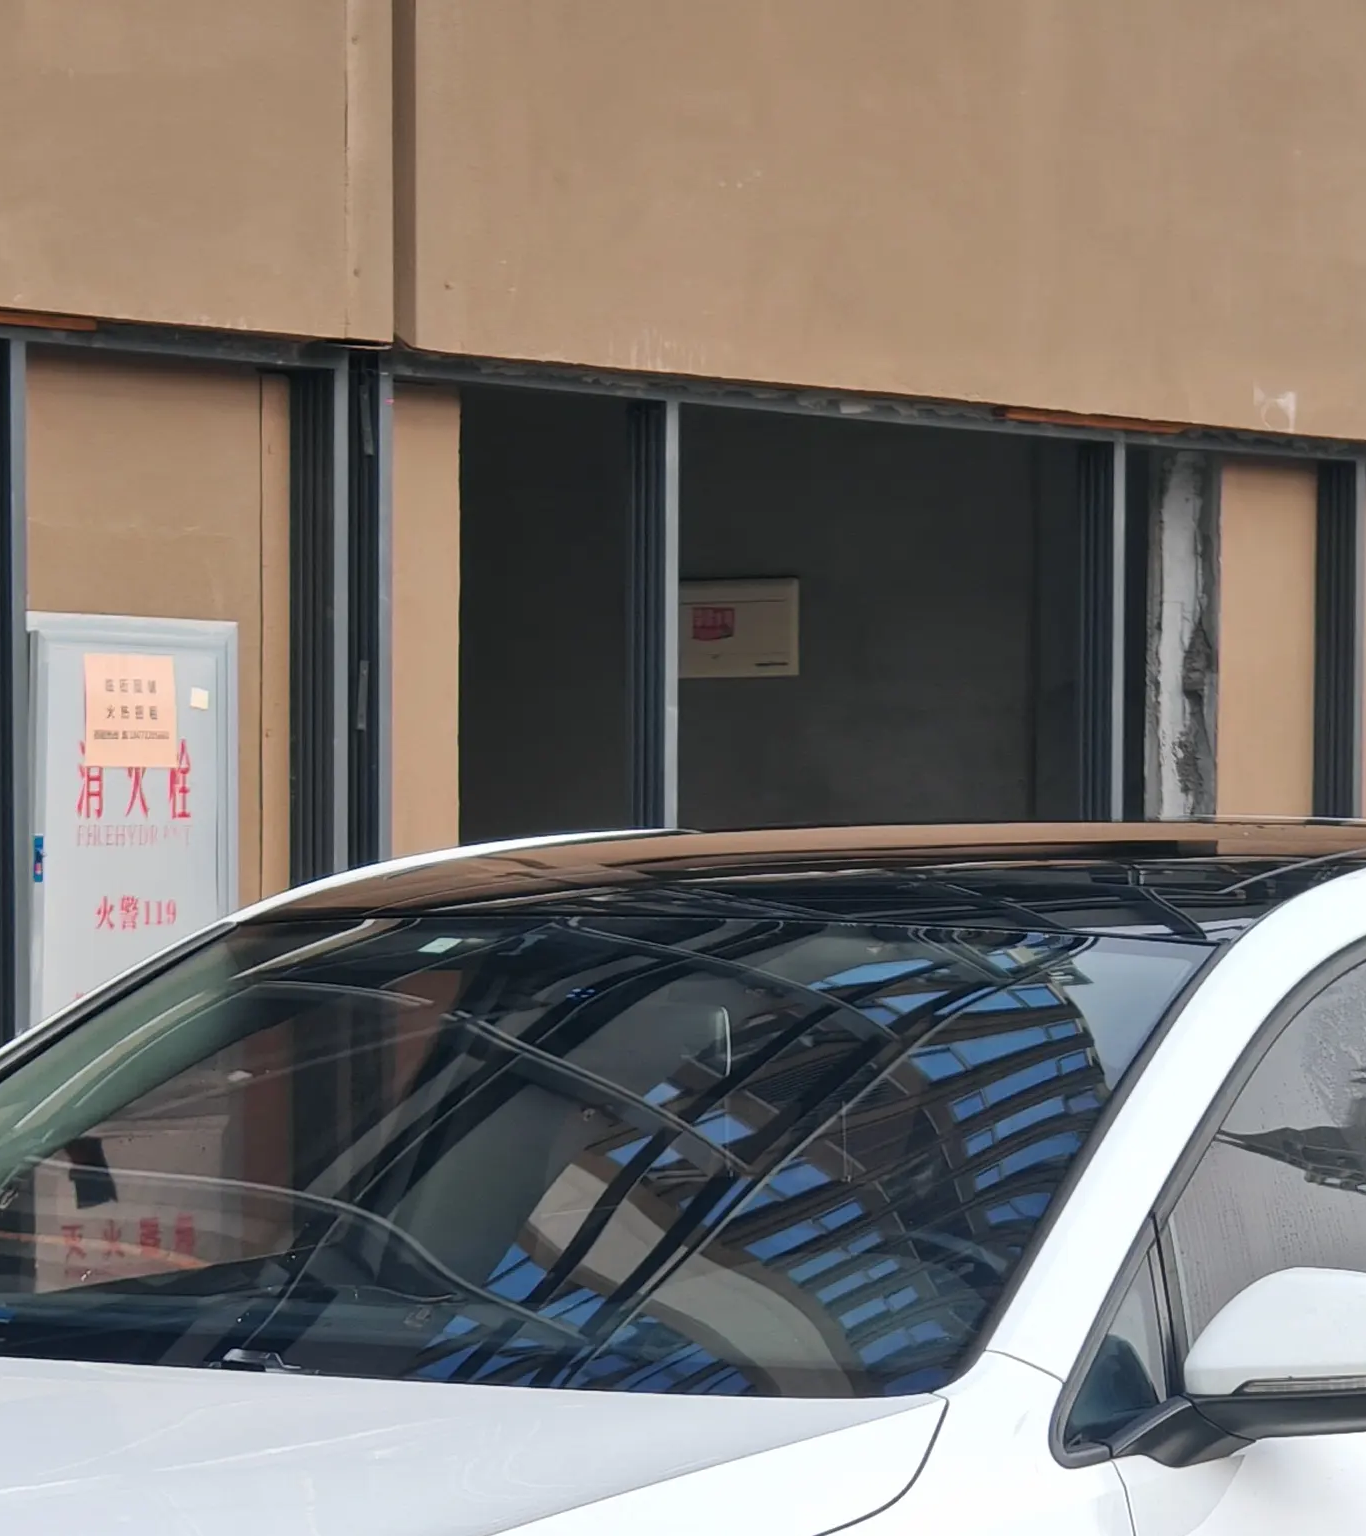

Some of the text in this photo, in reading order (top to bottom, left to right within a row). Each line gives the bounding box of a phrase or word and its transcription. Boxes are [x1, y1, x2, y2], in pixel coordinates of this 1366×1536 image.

[75, 739, 191, 819] 消火栓
[94, 894, 177, 930] 火警119
